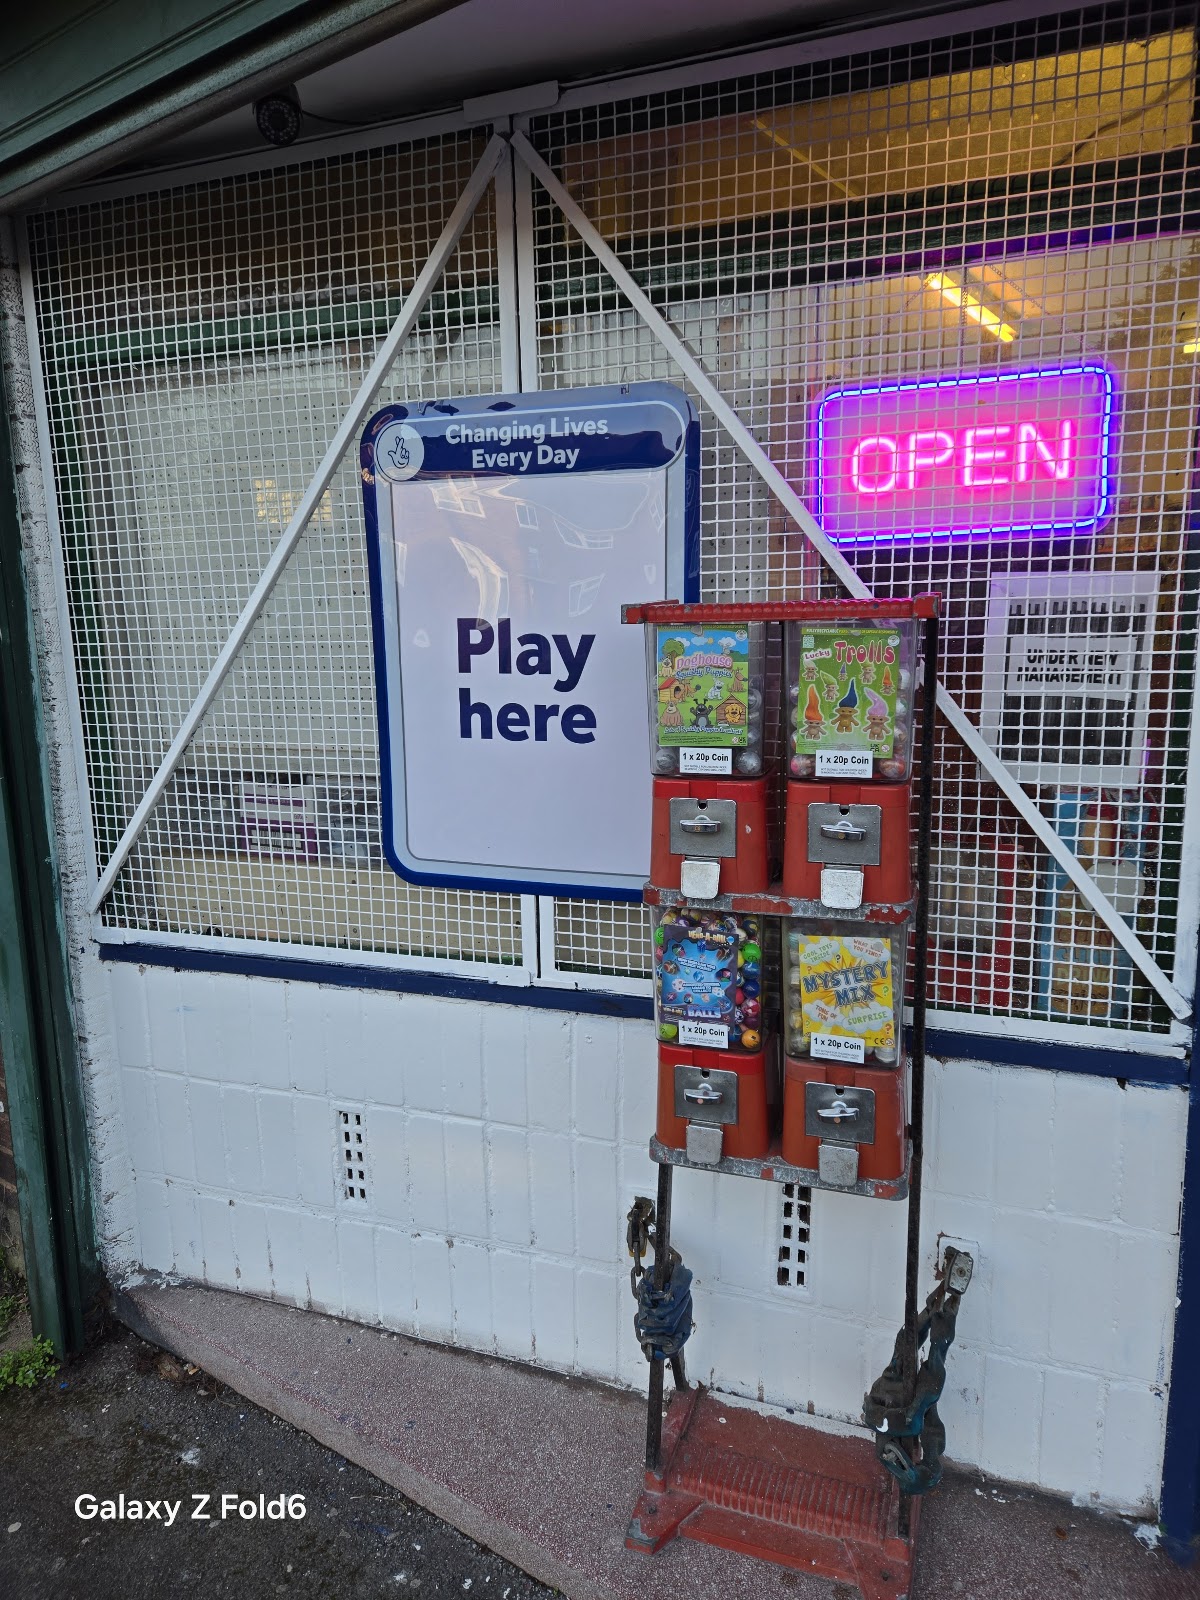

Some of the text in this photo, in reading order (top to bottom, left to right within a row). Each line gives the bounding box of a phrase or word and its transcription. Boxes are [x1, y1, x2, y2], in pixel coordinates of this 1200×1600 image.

[445, 416, 608, 447] Changing Lives
[472, 445, 580, 471] Every Day
[851, 419, 1073, 493] OPEN
[457, 617, 597, 693] Play
[804, 649, 831, 660] Lucky
[834, 639, 896, 665] Trolls
[1026, 648, 1119, 666] UNDER NEW
[676, 653, 733, 670] Doghouse
[1016, 666, 1125, 685] MANAGEMENT
[458, 687, 597, 744] here
[696, 753, 709, 763] 20p
[711, 753, 729, 762] Coin
[819, 755, 823, 763] 1
[834, 755, 848, 765] 20p
[851, 756, 869, 765] Coin
[803, 943, 833, 960] COOL TOYS
[853, 939, 869, 948] WHAT
[853, 944, 864, 952] YOU
[810, 951, 830, 963] INSIDE
[802, 961, 888, 994] MYSTERY
[834, 984, 877, 1007] MIX
[687, 1006, 721, 1018] BALLS
[815, 1004, 828, 1015] TONS
[817, 1012, 829, 1022] FUN
[847, 1011, 888, 1026] SURPRISE
[694, 1026, 707, 1036] 20p
[709, 1028, 725, 1037] Coin
[827, 1039, 842, 1049] 20p
[844, 1041, 862, 1051] Coin
